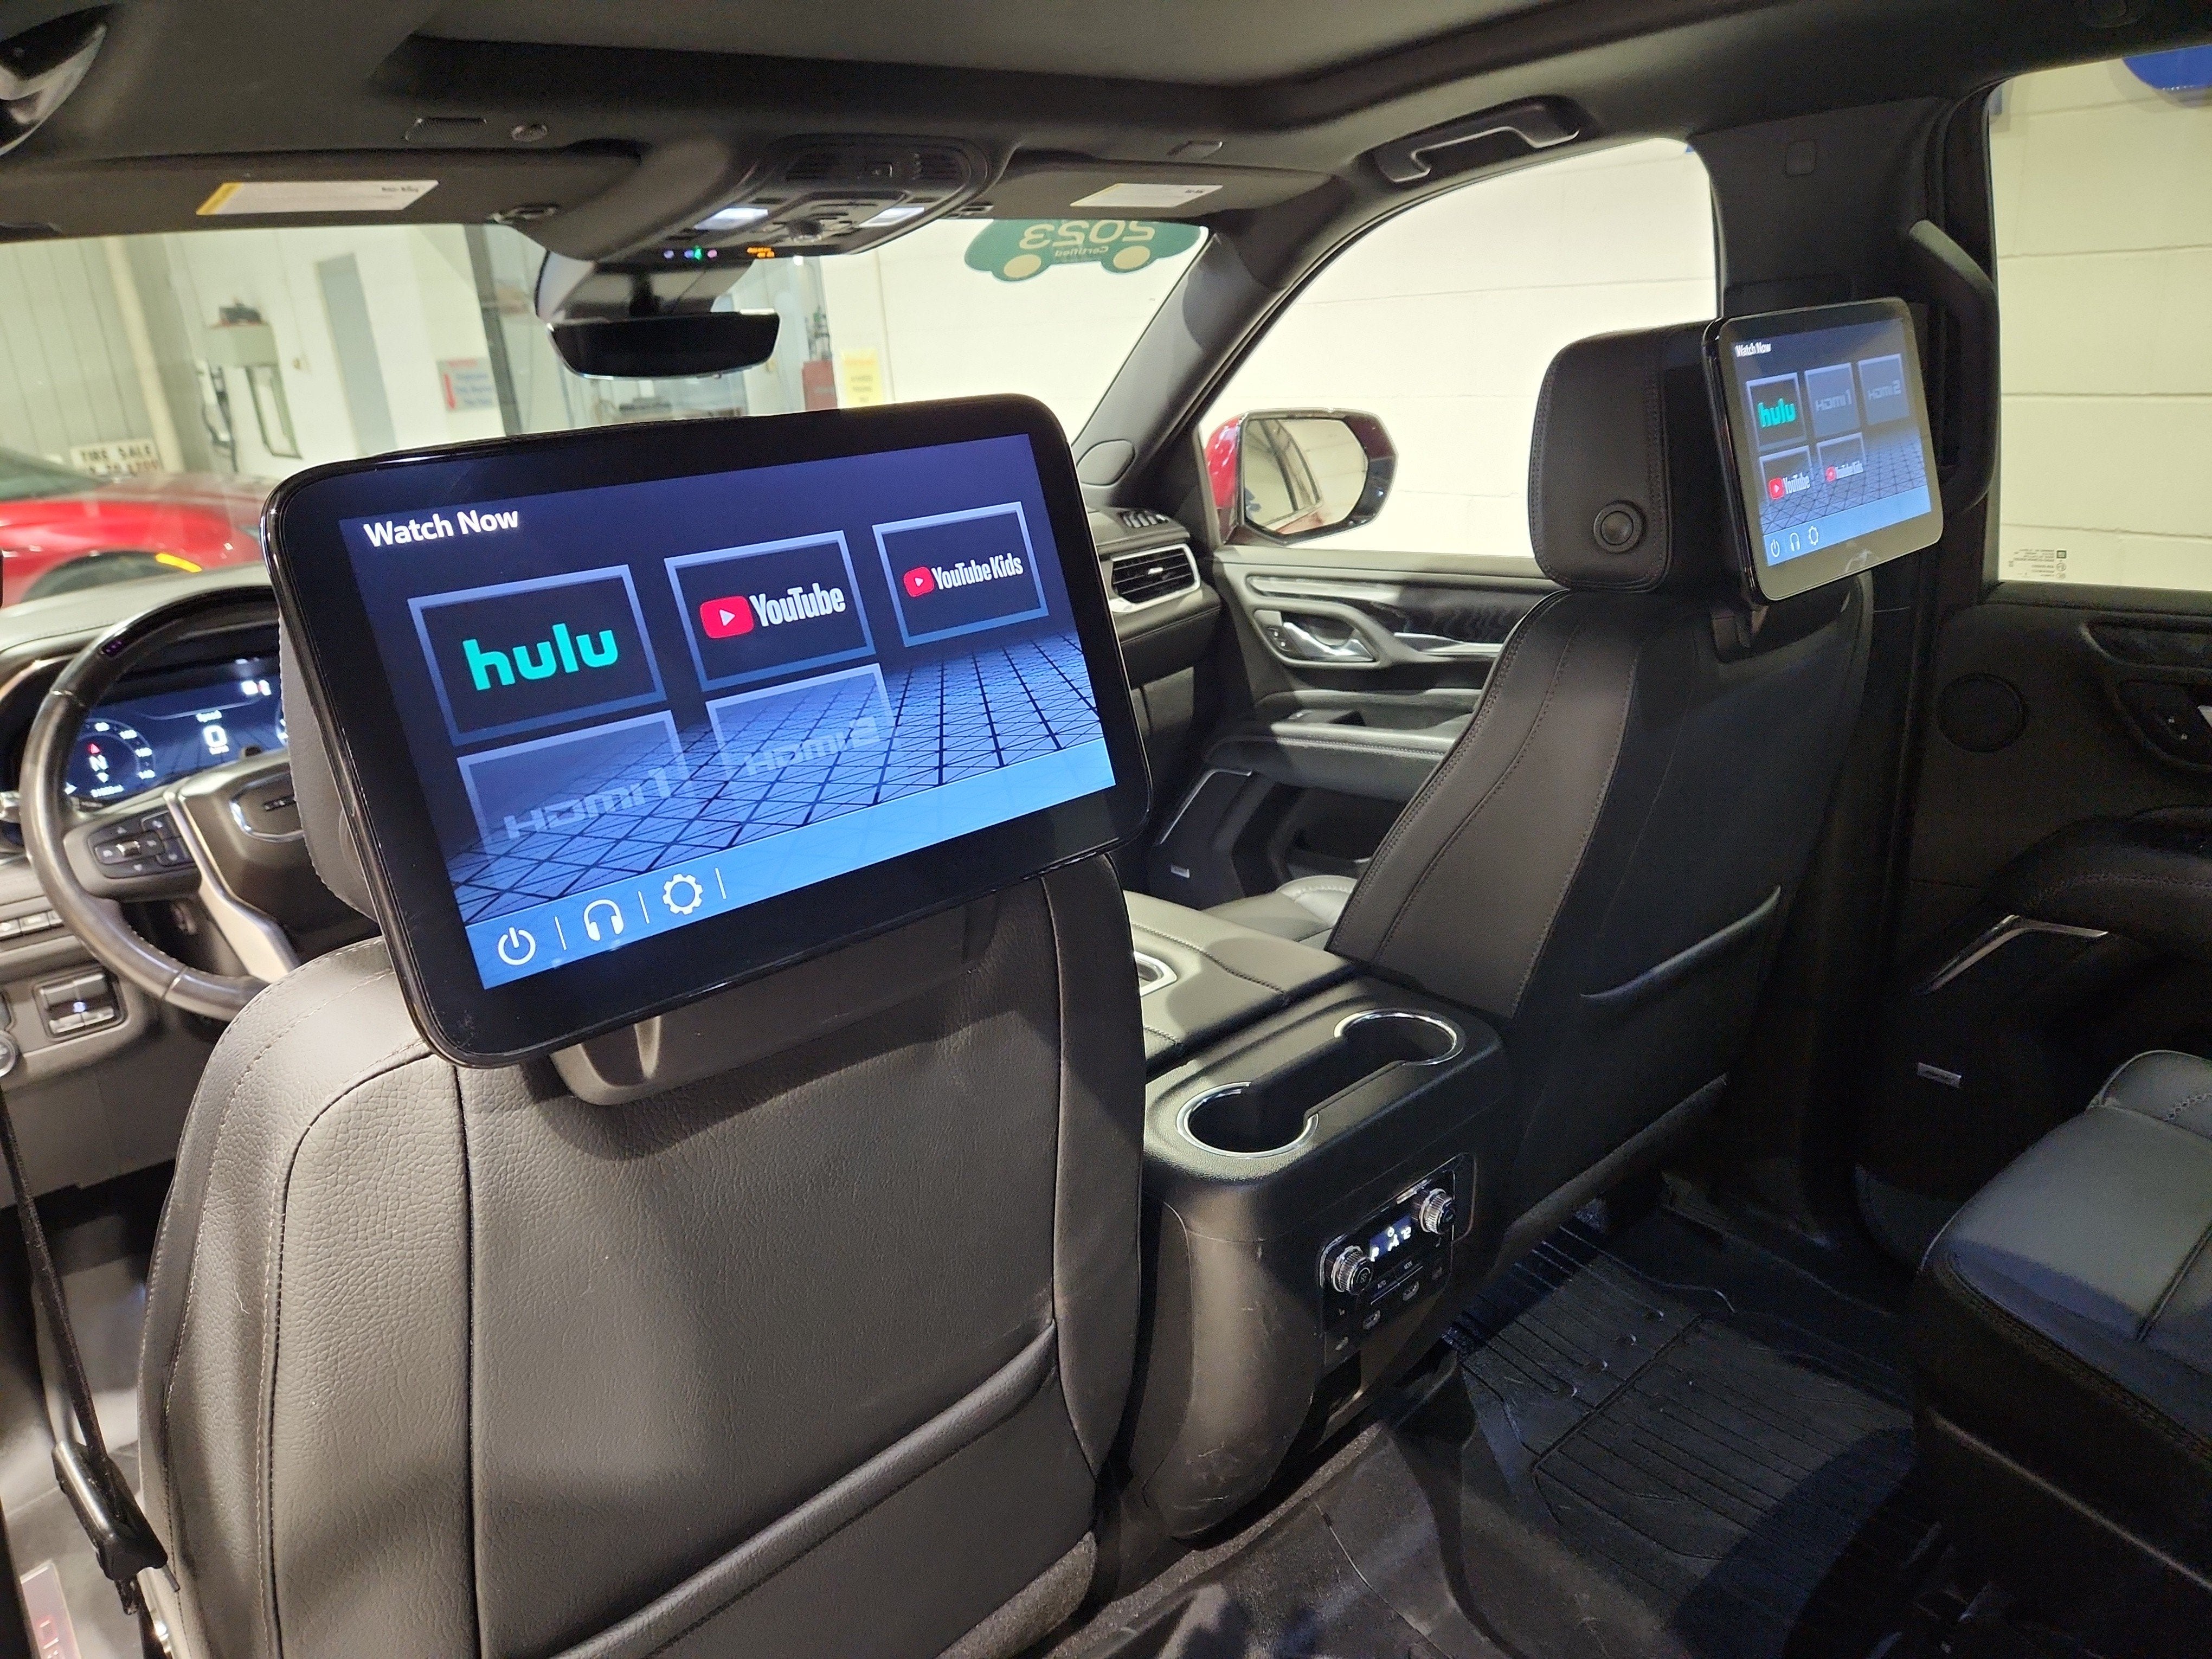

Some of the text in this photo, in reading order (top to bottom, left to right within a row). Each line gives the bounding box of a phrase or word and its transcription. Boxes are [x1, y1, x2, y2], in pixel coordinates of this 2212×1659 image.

[1735, 342, 1771, 357] Watch Now
[1758, 398, 1796, 427] hulu
[1783, 472, 1810, 494] YouTube
[363, 510, 519, 548] Watch Now
[931, 554, 1023, 590] YouTube Kids
[749, 583, 846, 626] YouTube
[462, 623, 618, 691] hulu
[203, 725, 227, 748] 0
